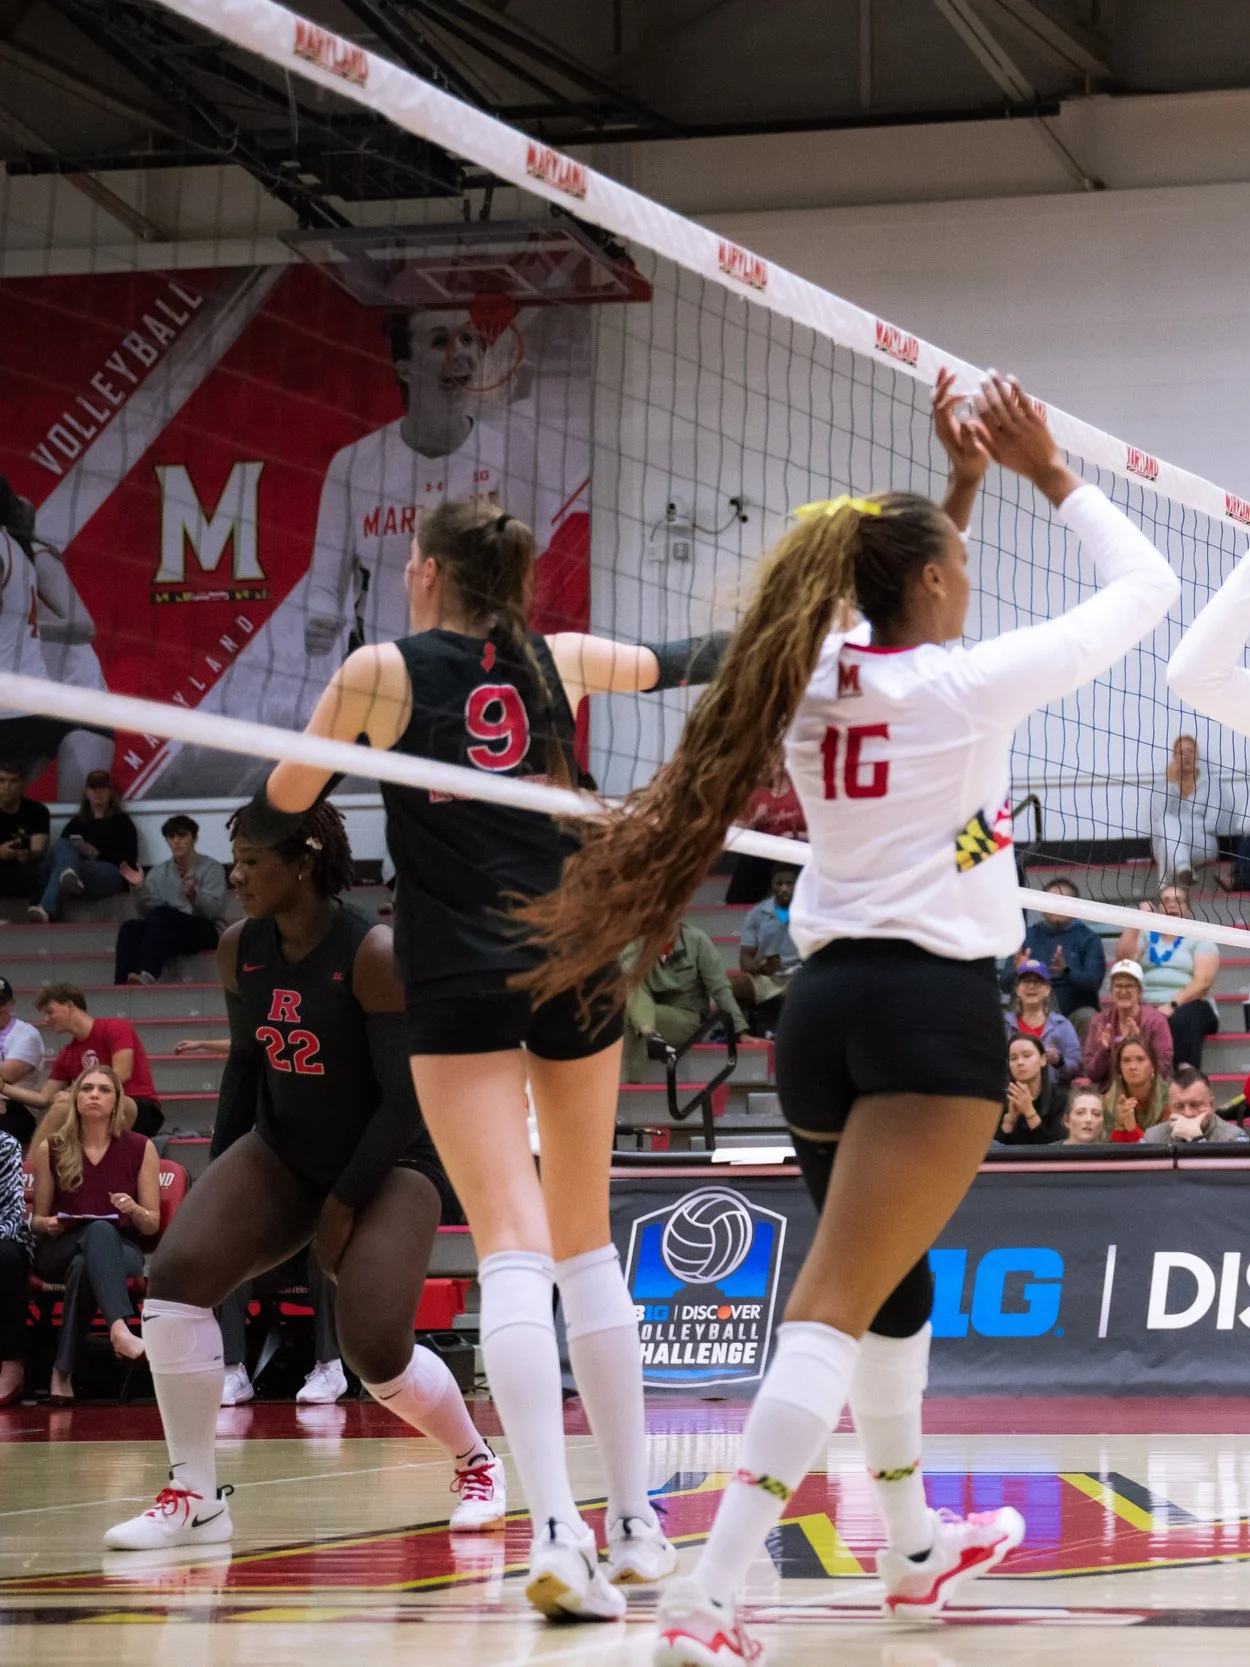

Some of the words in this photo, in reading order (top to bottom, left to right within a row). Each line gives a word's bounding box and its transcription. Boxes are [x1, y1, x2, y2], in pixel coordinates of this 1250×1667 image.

[30, 281, 204, 477] VOLLEYBALL
[154, 461, 266, 583] M
[123, 614, 255, 772] MAYLAND
[465, 683, 531, 772] 9
[820, 722, 891, 801] 16
[267, 988, 303, 1023] R
[255, 1026, 325, 1075] 22
[641, 1323, 759, 1341] OLLEYBALL
[682, 1304, 760, 1320] DISCOVER
[640, 1342, 758, 1364] HALLENGE
